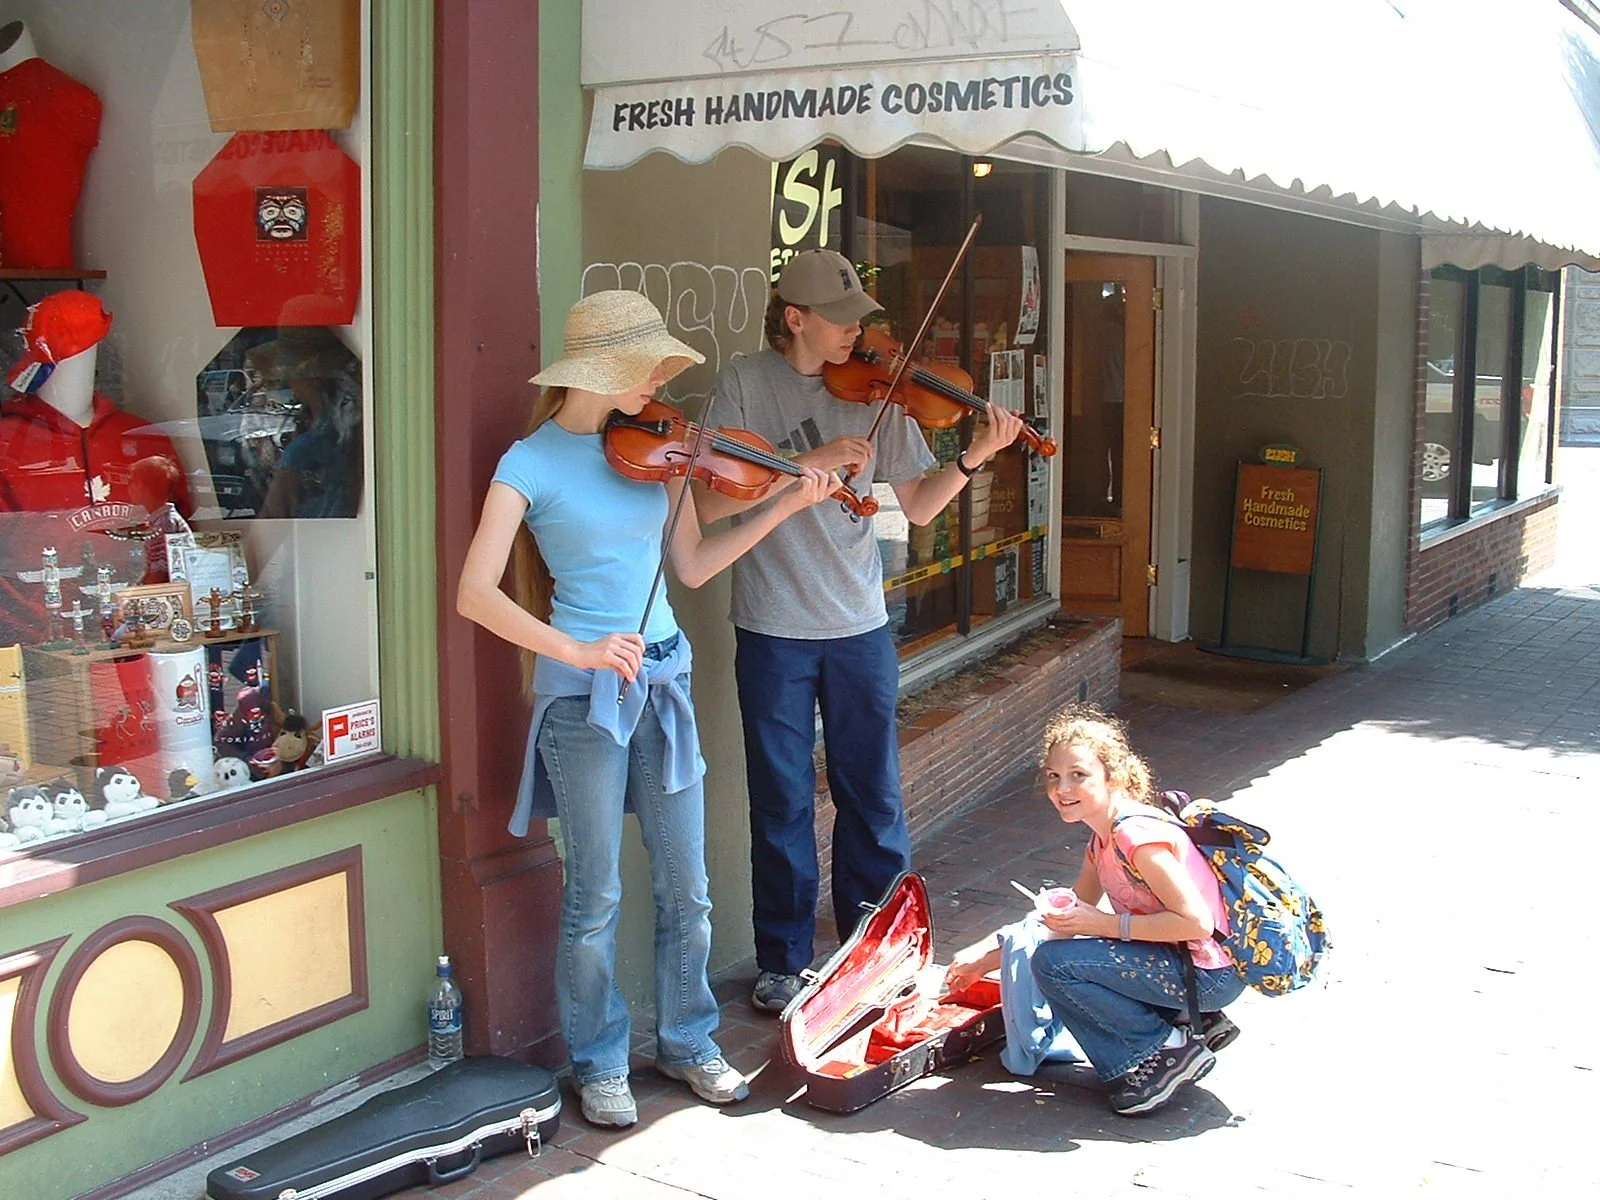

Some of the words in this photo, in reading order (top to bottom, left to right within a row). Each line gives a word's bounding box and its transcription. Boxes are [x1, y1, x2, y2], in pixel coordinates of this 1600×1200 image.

[612, 97, 695, 132] FRESH
[704, 83, 874, 127] HANDMADE
[880, 73, 1074, 115] COSMETICS
[1261, 485, 1295, 502] Fresh
[71, 504, 130, 528] CANADA
[1243, 498, 1311, 519] Handmade
[1244, 511, 1307, 532] Cosmetics
